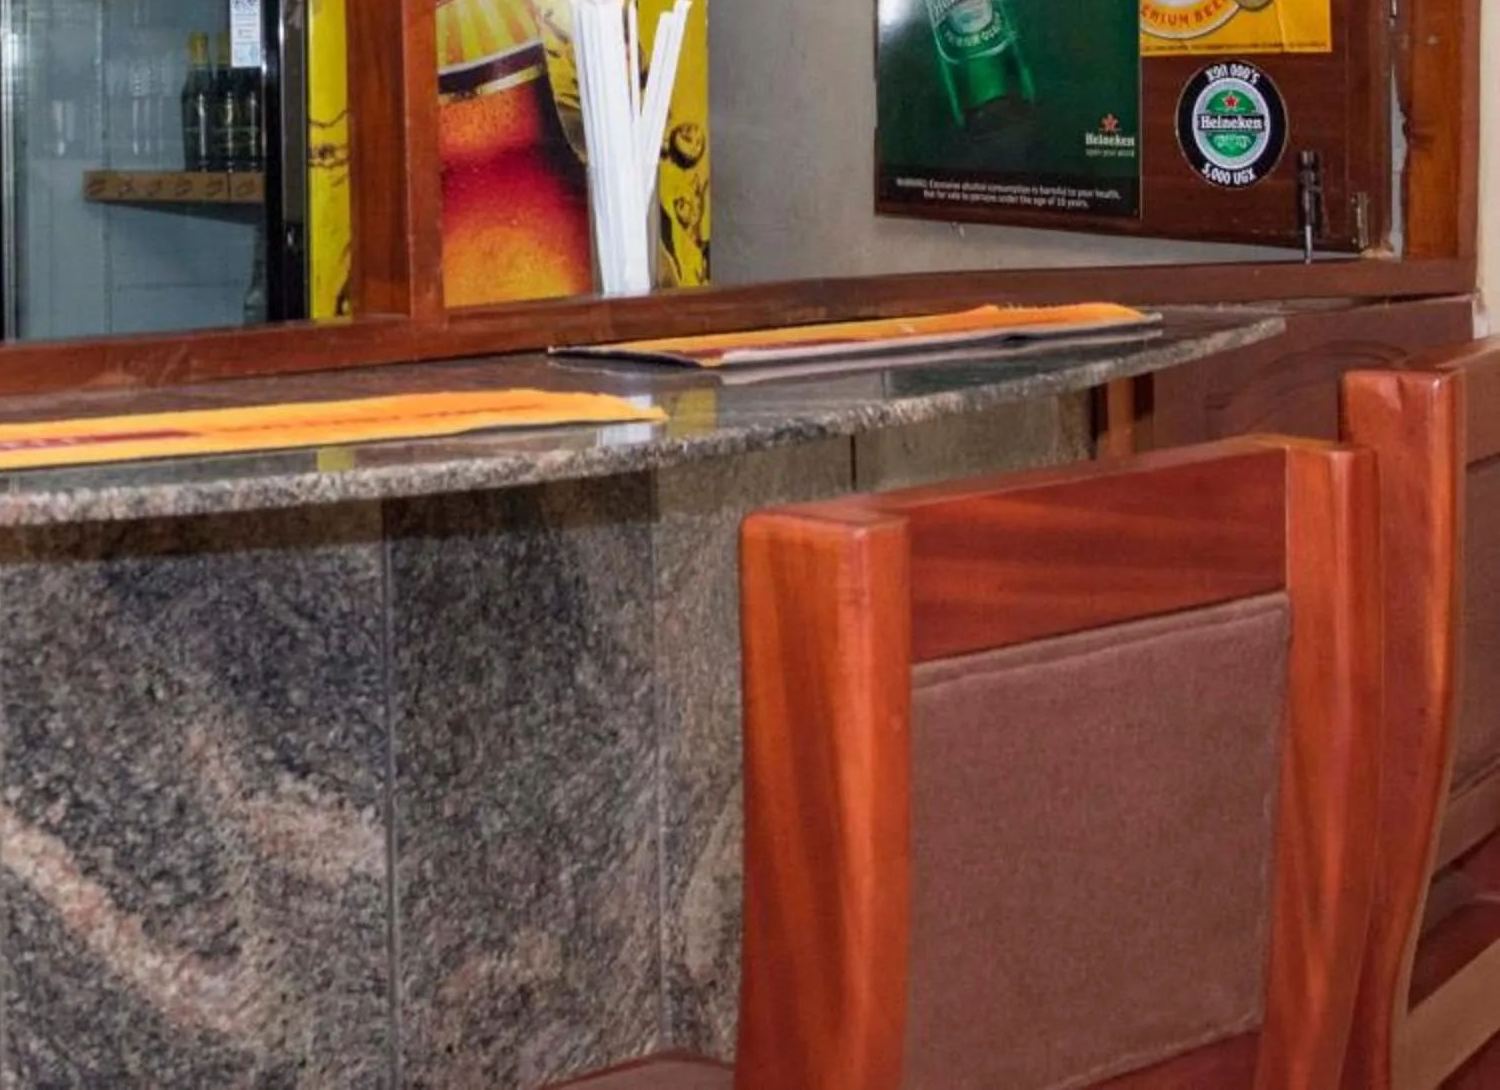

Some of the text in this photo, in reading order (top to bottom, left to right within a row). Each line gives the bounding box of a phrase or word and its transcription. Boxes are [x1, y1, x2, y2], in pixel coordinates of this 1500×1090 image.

[1200, 114, 1263, 130] Heineken
[1084, 132, 1135, 146] Heineken
[1233, 167, 1258, 185] UGX
